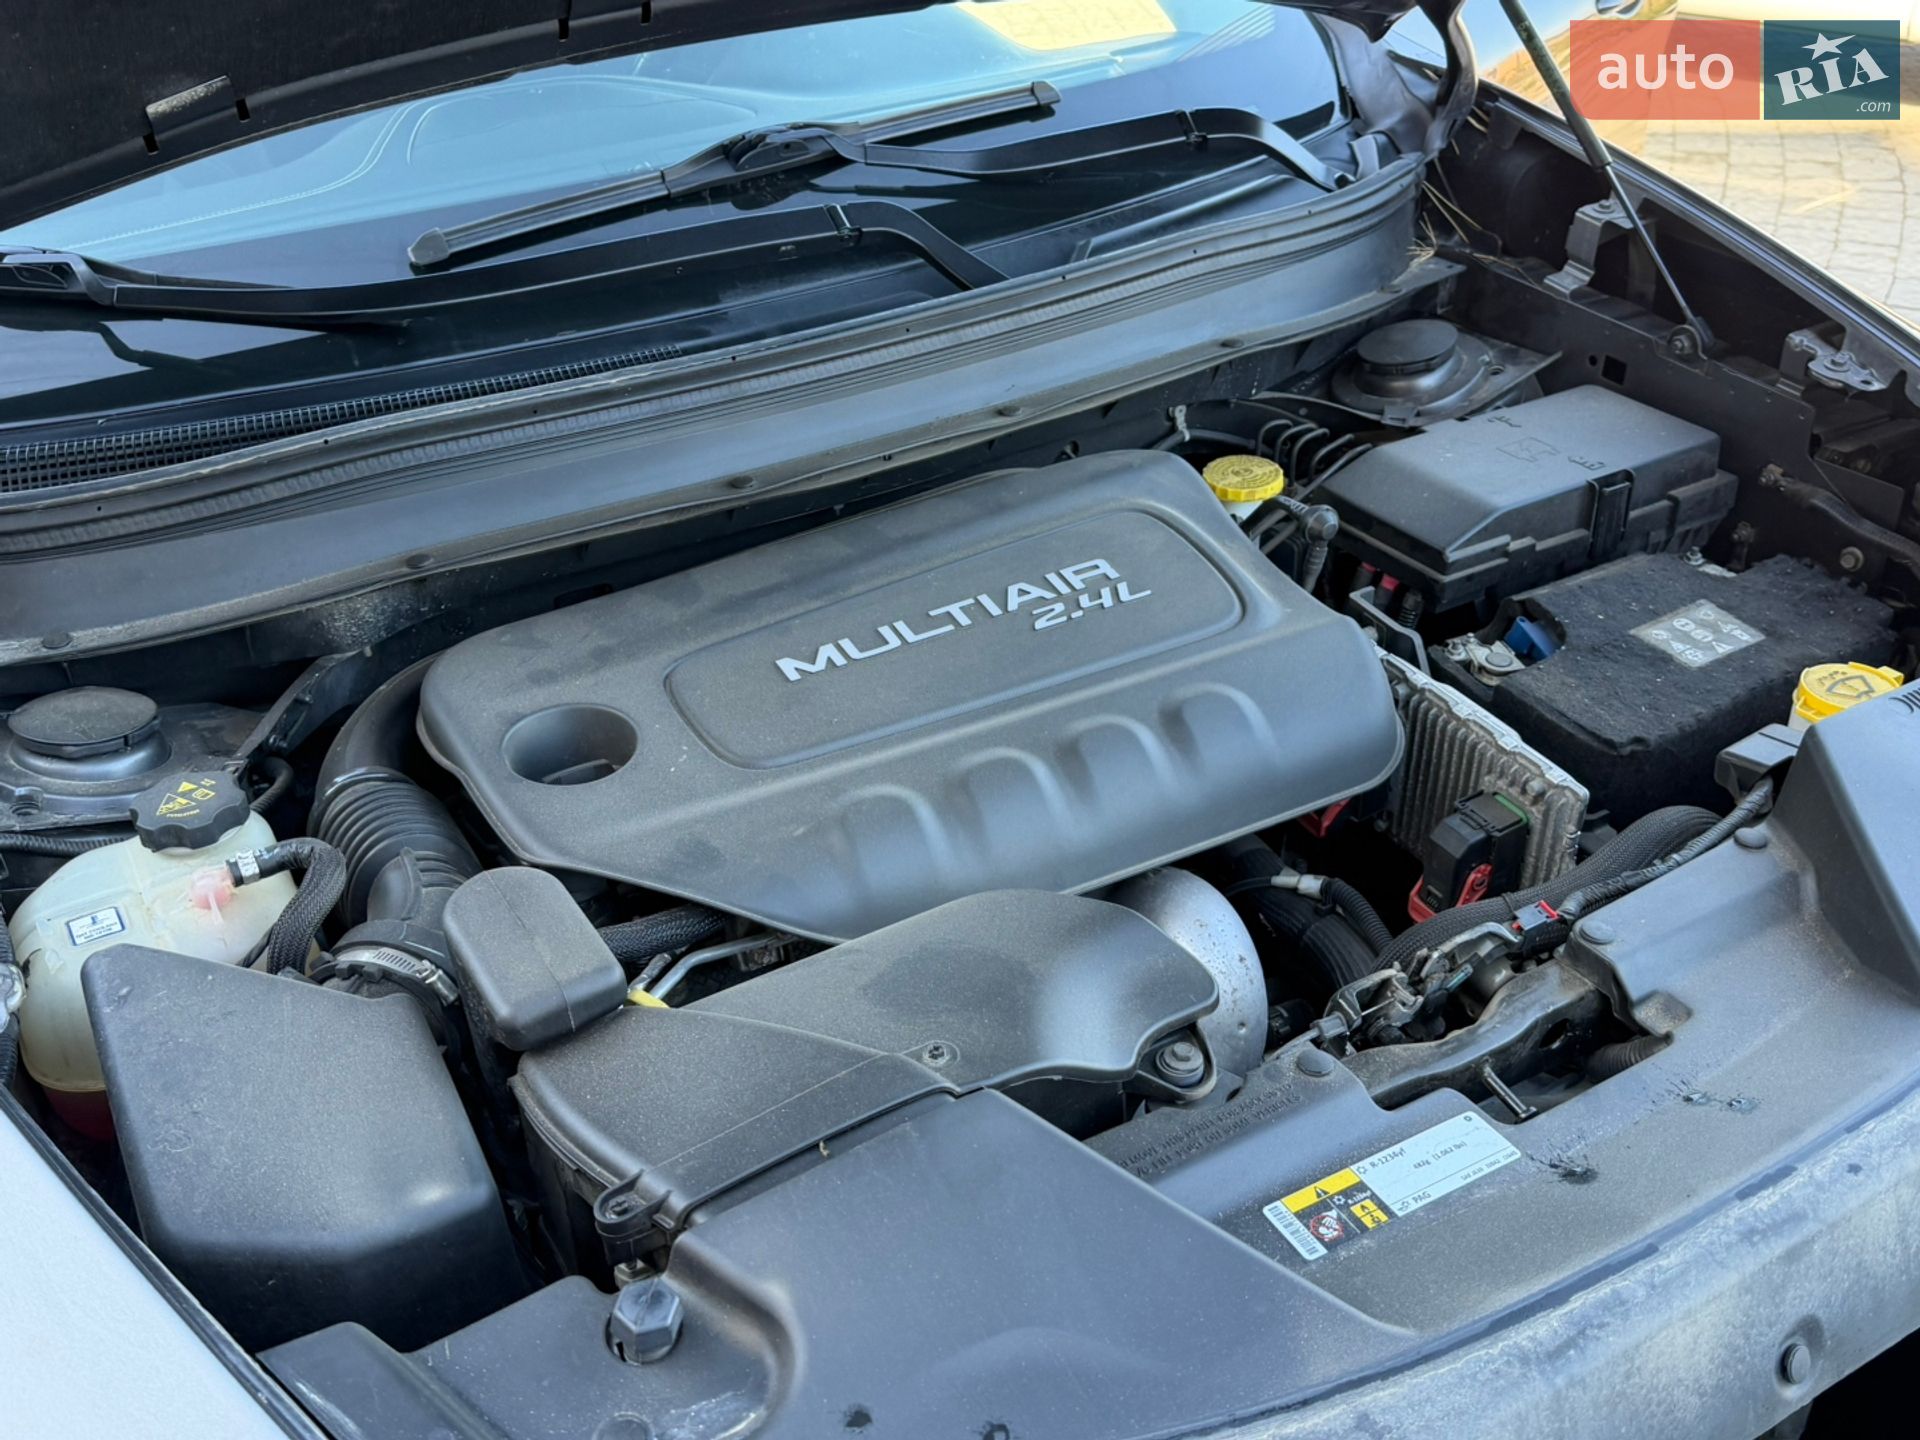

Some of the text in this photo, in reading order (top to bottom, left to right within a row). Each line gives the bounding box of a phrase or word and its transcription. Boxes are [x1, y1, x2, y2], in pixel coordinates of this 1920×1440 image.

[775, 558, 1121, 683] MULTIAIR
[1032, 581, 1152, 631] 2.4L
[1411, 1191, 1432, 1204] PAG
